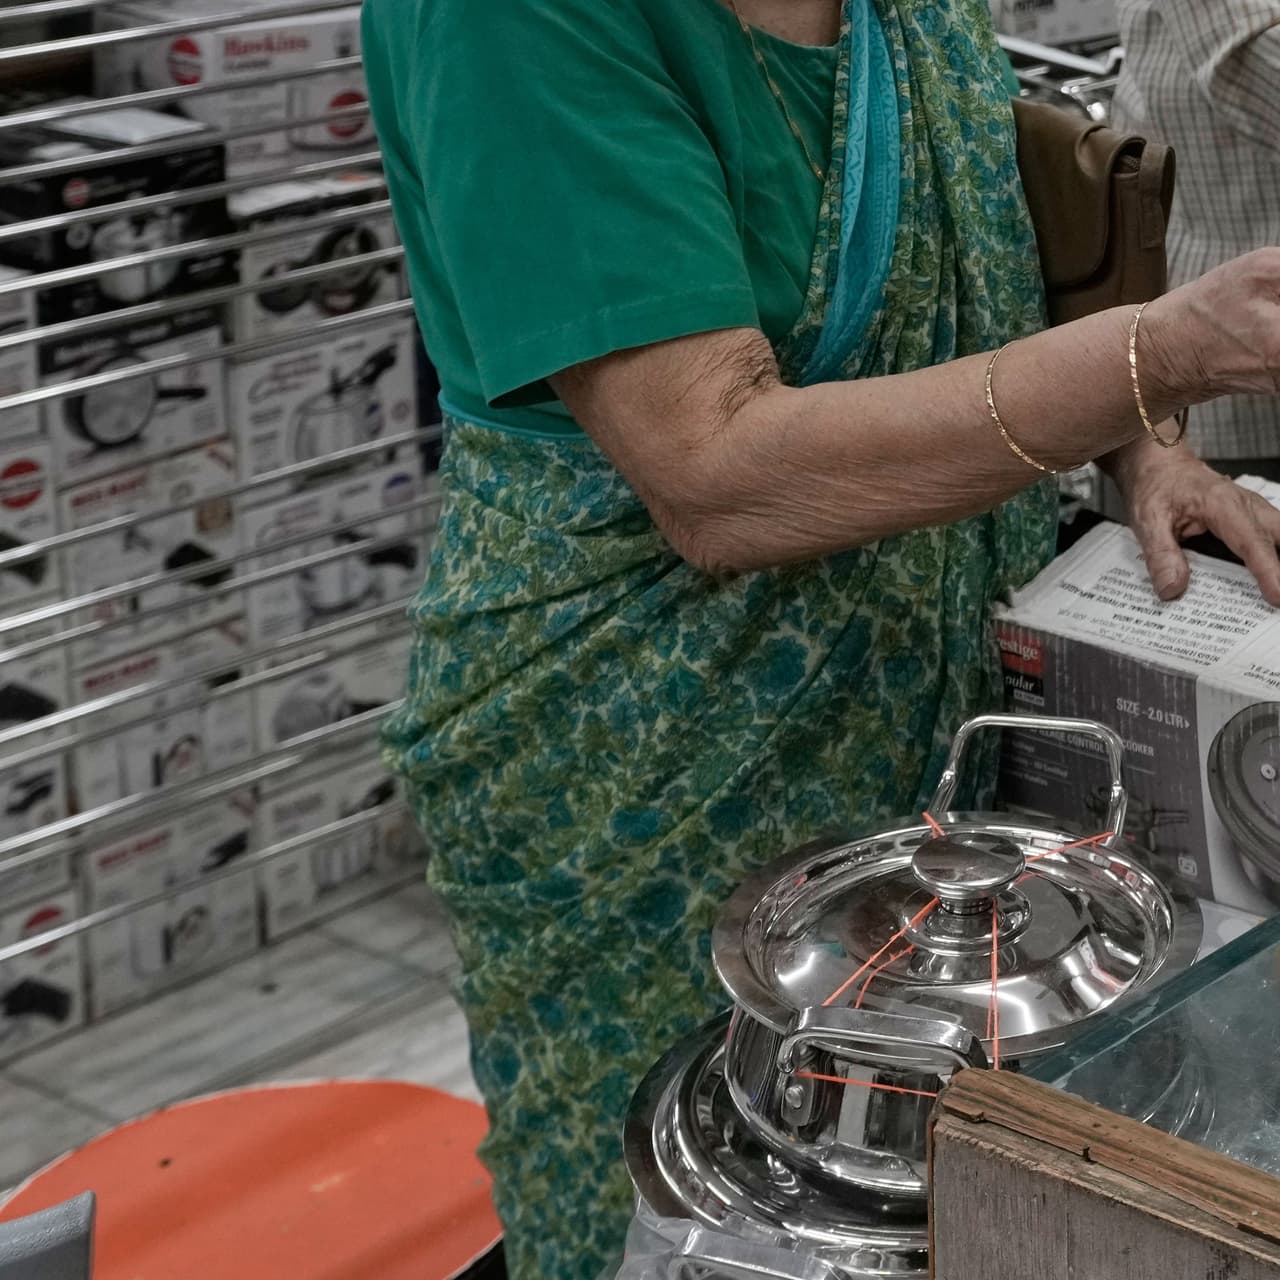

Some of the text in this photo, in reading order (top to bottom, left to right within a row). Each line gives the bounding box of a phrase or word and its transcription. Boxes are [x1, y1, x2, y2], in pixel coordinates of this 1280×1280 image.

[999, 637, 1040, 661] estige
[1115, 697, 1142, 718] SIZE
[1163, 711, 1184, 730] LTR
[1066, 733, 1155, 757] CONTROL COOKER
